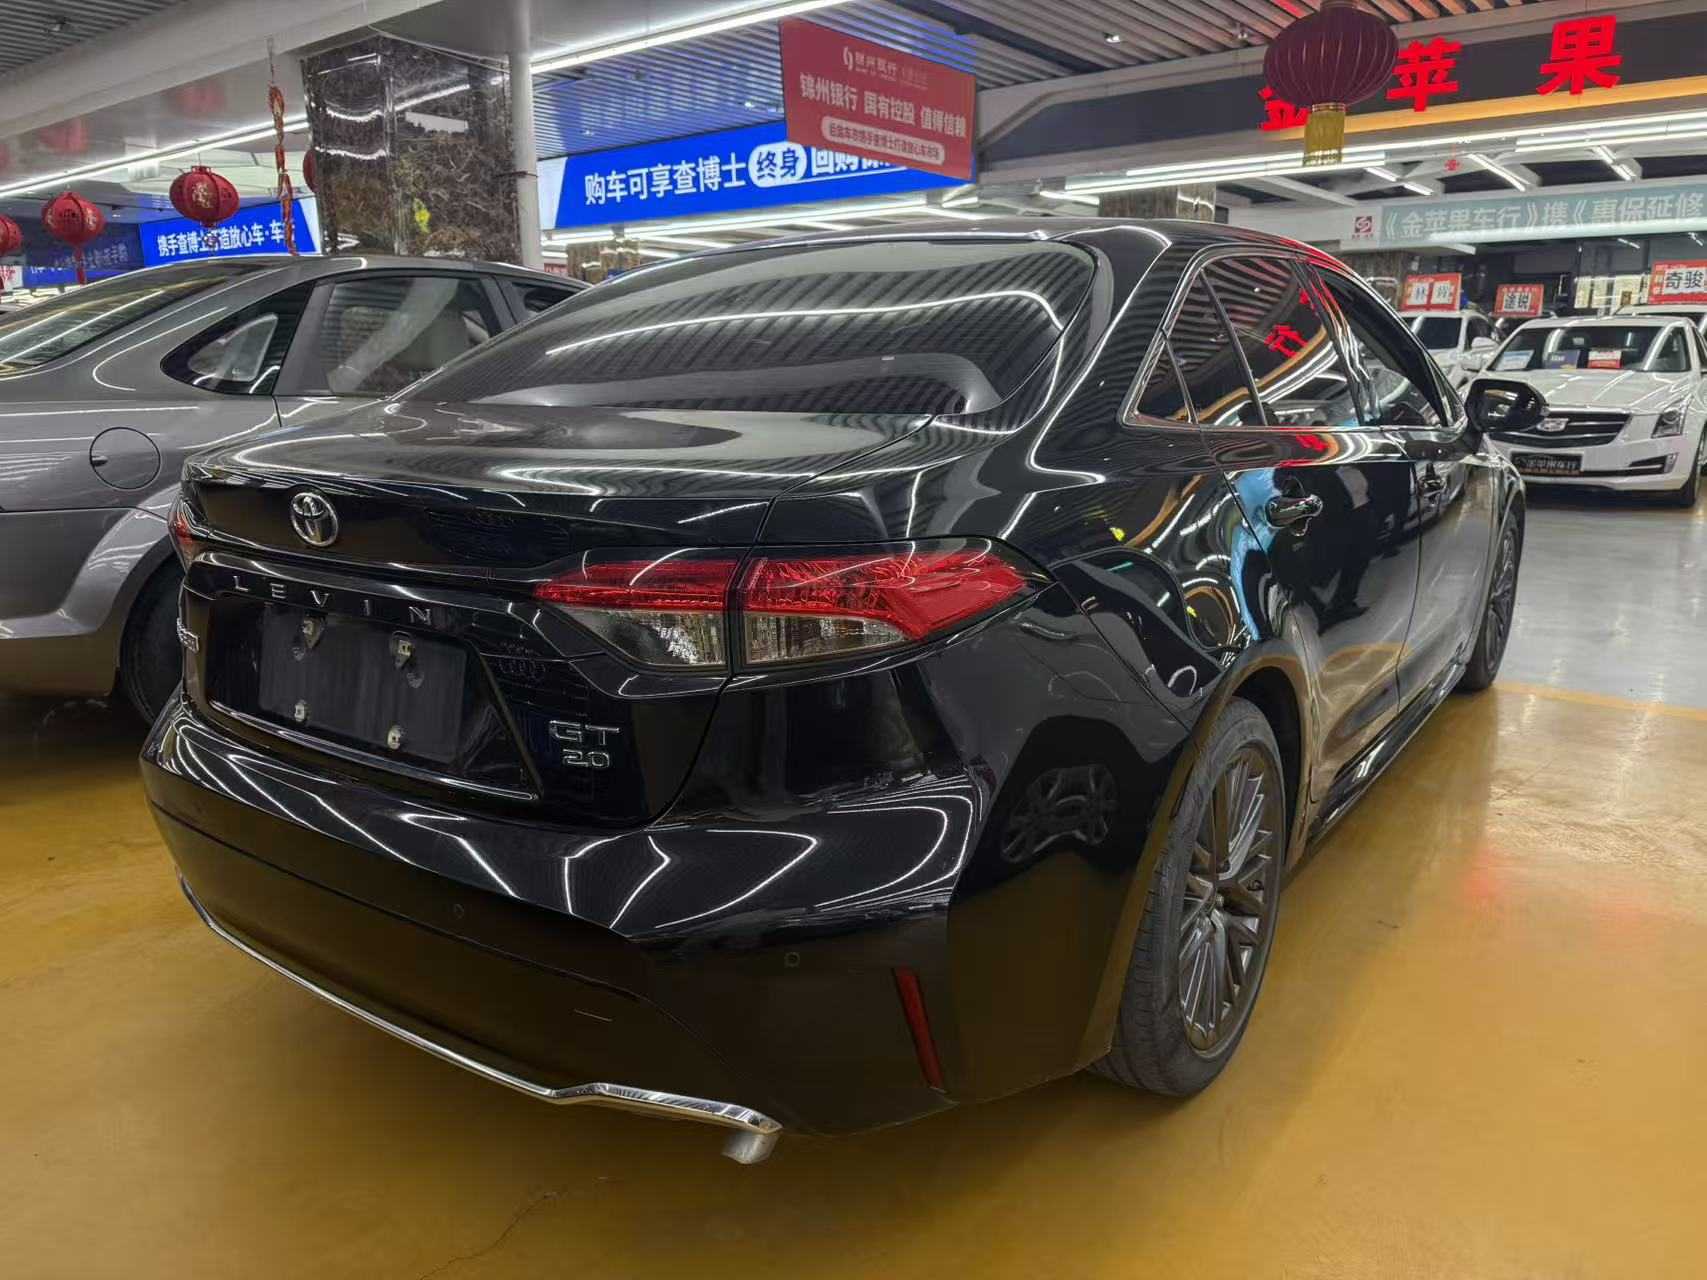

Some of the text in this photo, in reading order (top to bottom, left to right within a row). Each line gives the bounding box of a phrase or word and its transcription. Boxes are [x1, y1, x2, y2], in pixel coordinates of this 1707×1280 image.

[799, 72, 858, 111] 锦州银行
[864, 90, 915, 126] 国有控股
[920, 106, 966, 138] 值得信赖
[1665, 270, 1704, 289] 奇骏
[232, 575, 432, 626] LEVIN
[549, 720, 620, 746] GT
